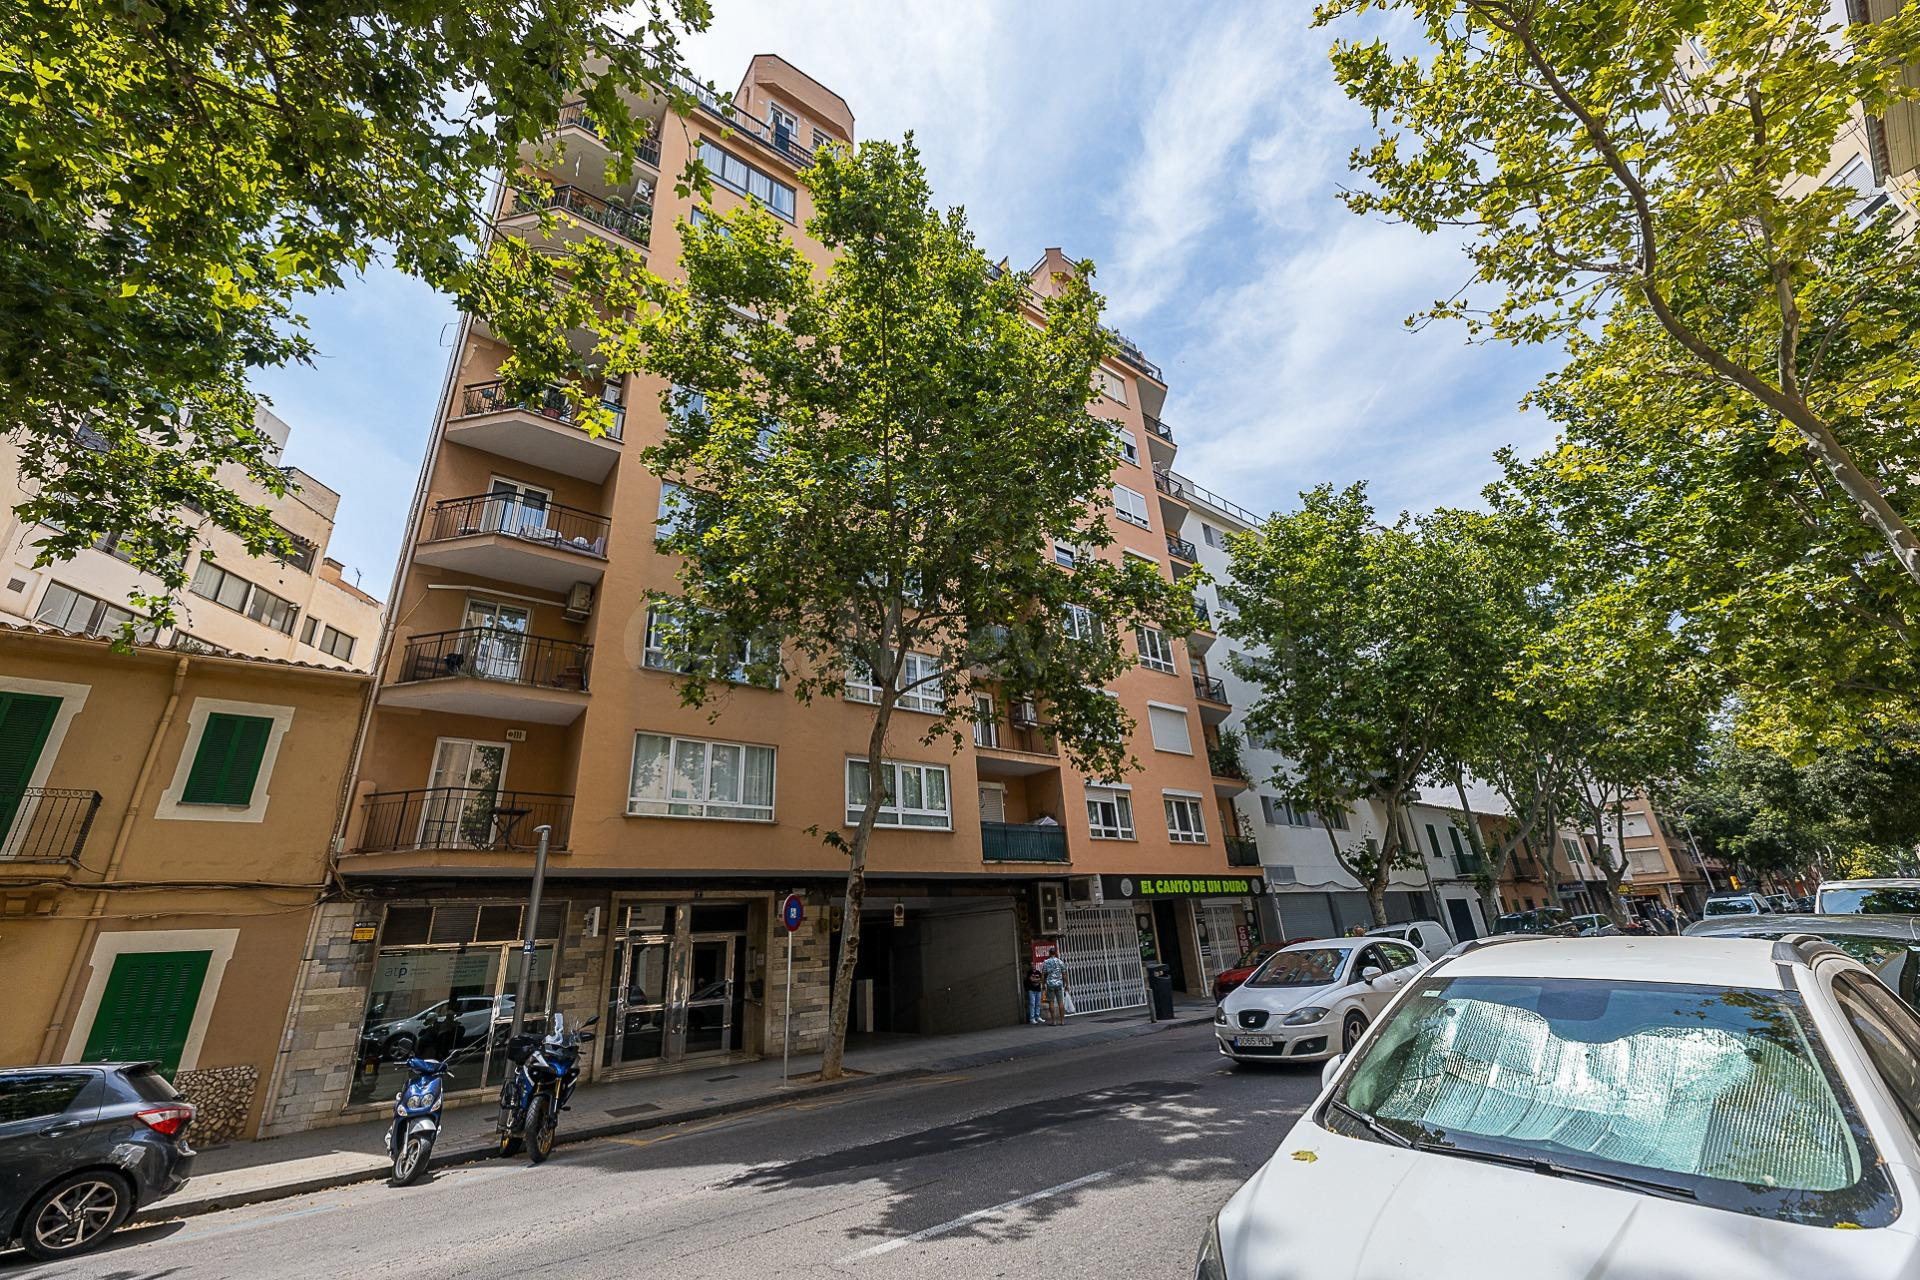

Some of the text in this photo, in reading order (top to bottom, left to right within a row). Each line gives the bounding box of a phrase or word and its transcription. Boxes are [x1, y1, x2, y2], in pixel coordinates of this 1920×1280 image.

[1140, 880, 1249, 894] EL CANTO DE UN DURO
